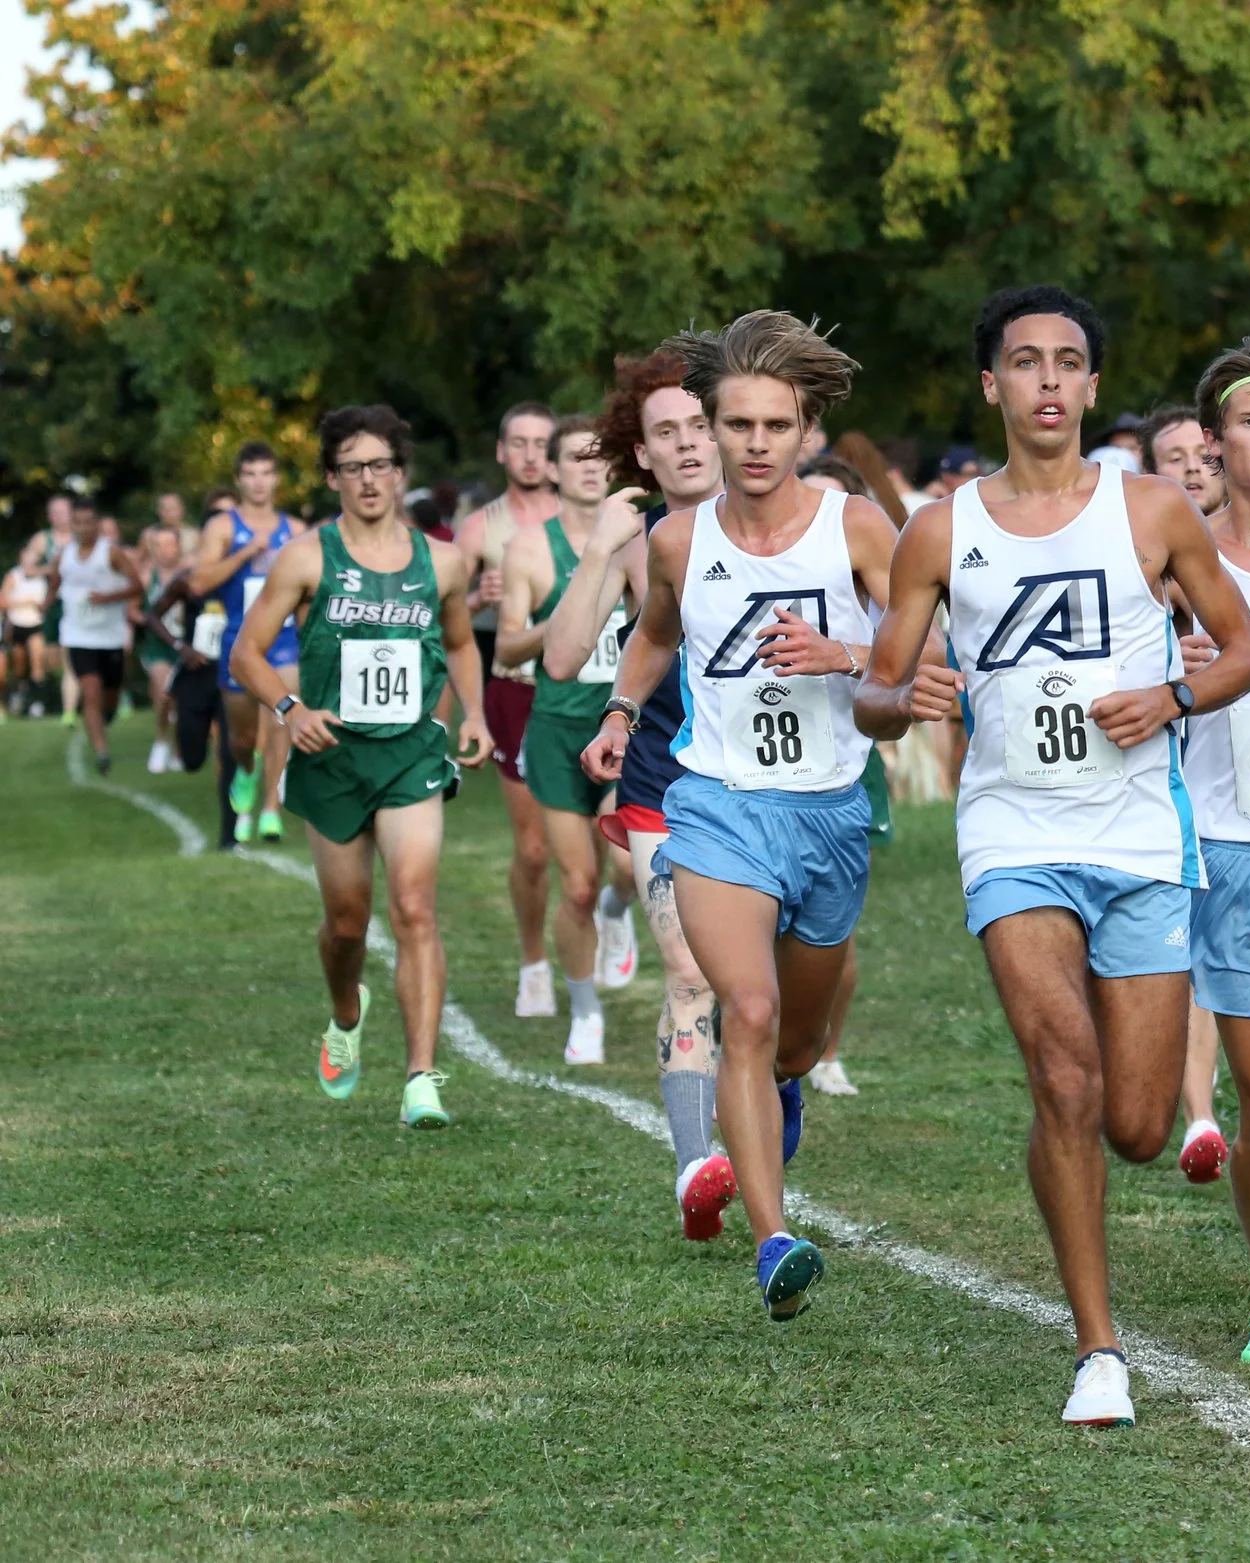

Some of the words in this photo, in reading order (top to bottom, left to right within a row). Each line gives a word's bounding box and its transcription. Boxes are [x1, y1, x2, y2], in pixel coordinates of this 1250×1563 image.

[702, 572, 731, 581] adidas
[959, 559, 989, 570] adidas
[326, 596, 433, 631] Upstate
[595, 635, 617, 667] 19
[358, 667, 409, 706] 194
[753, 686, 763, 698] EYE
[765, 681, 791, 695] OPENER
[1036, 675, 1046, 688] EYE
[1048, 670, 1077, 684] OPENER
[753, 711, 802, 767] 38
[1035, 703, 1087, 764] 36
